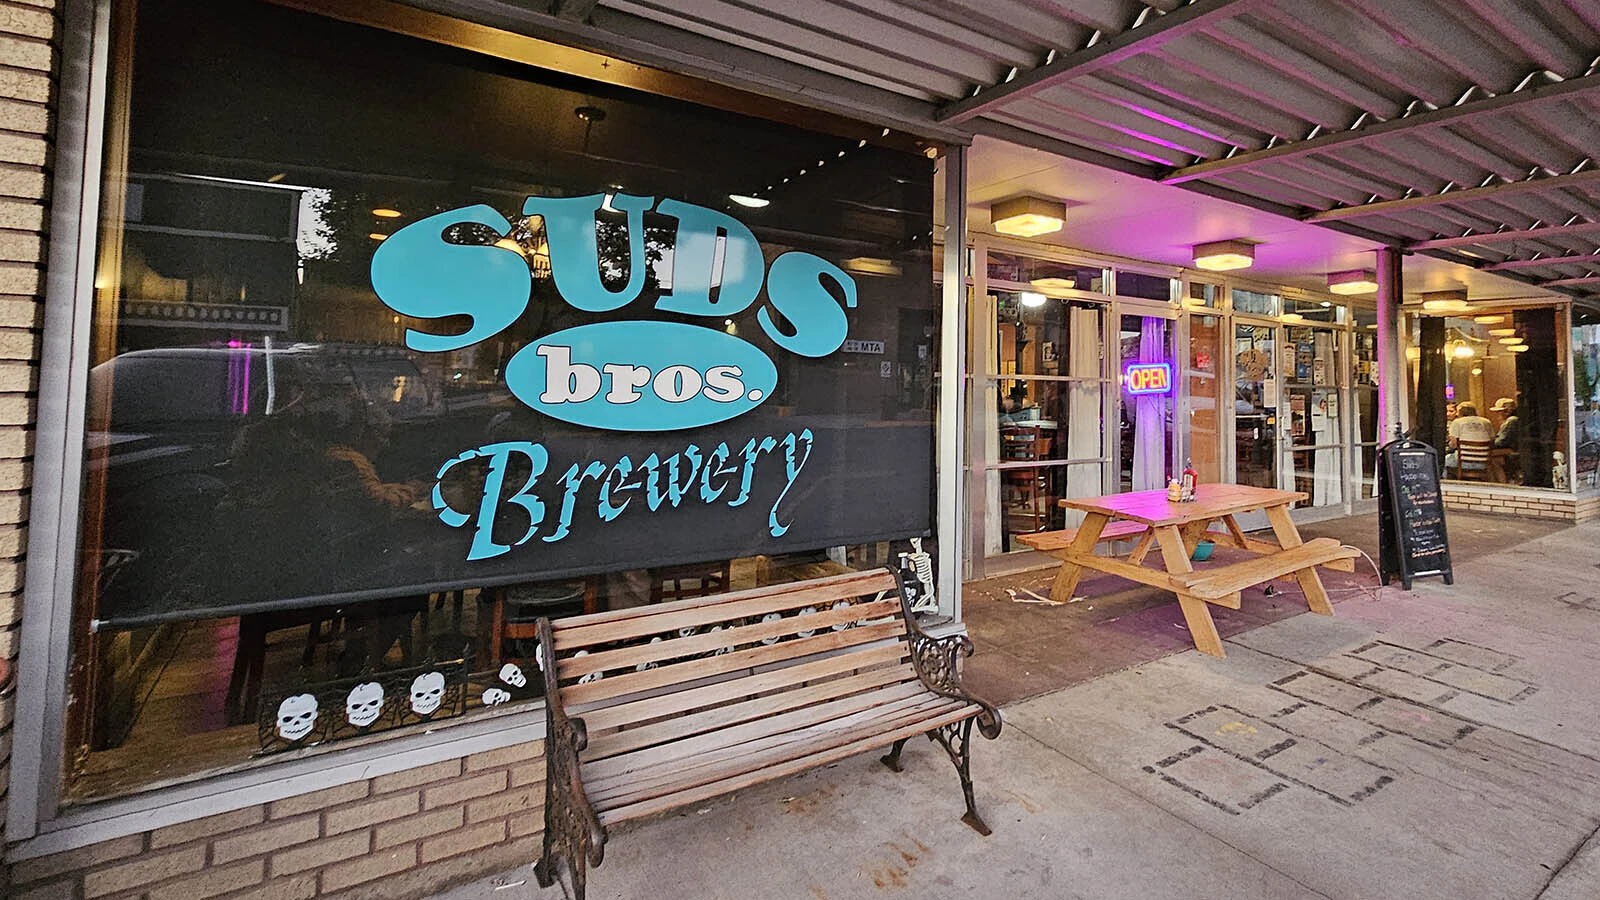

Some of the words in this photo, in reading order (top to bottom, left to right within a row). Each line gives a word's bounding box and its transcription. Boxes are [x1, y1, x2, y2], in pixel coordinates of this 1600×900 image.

[370, 193, 857, 357] SUDS
[536, 344, 764, 404] bros.
[1131, 367, 1168, 390] OPEN
[432, 428, 813, 561] Brewery
